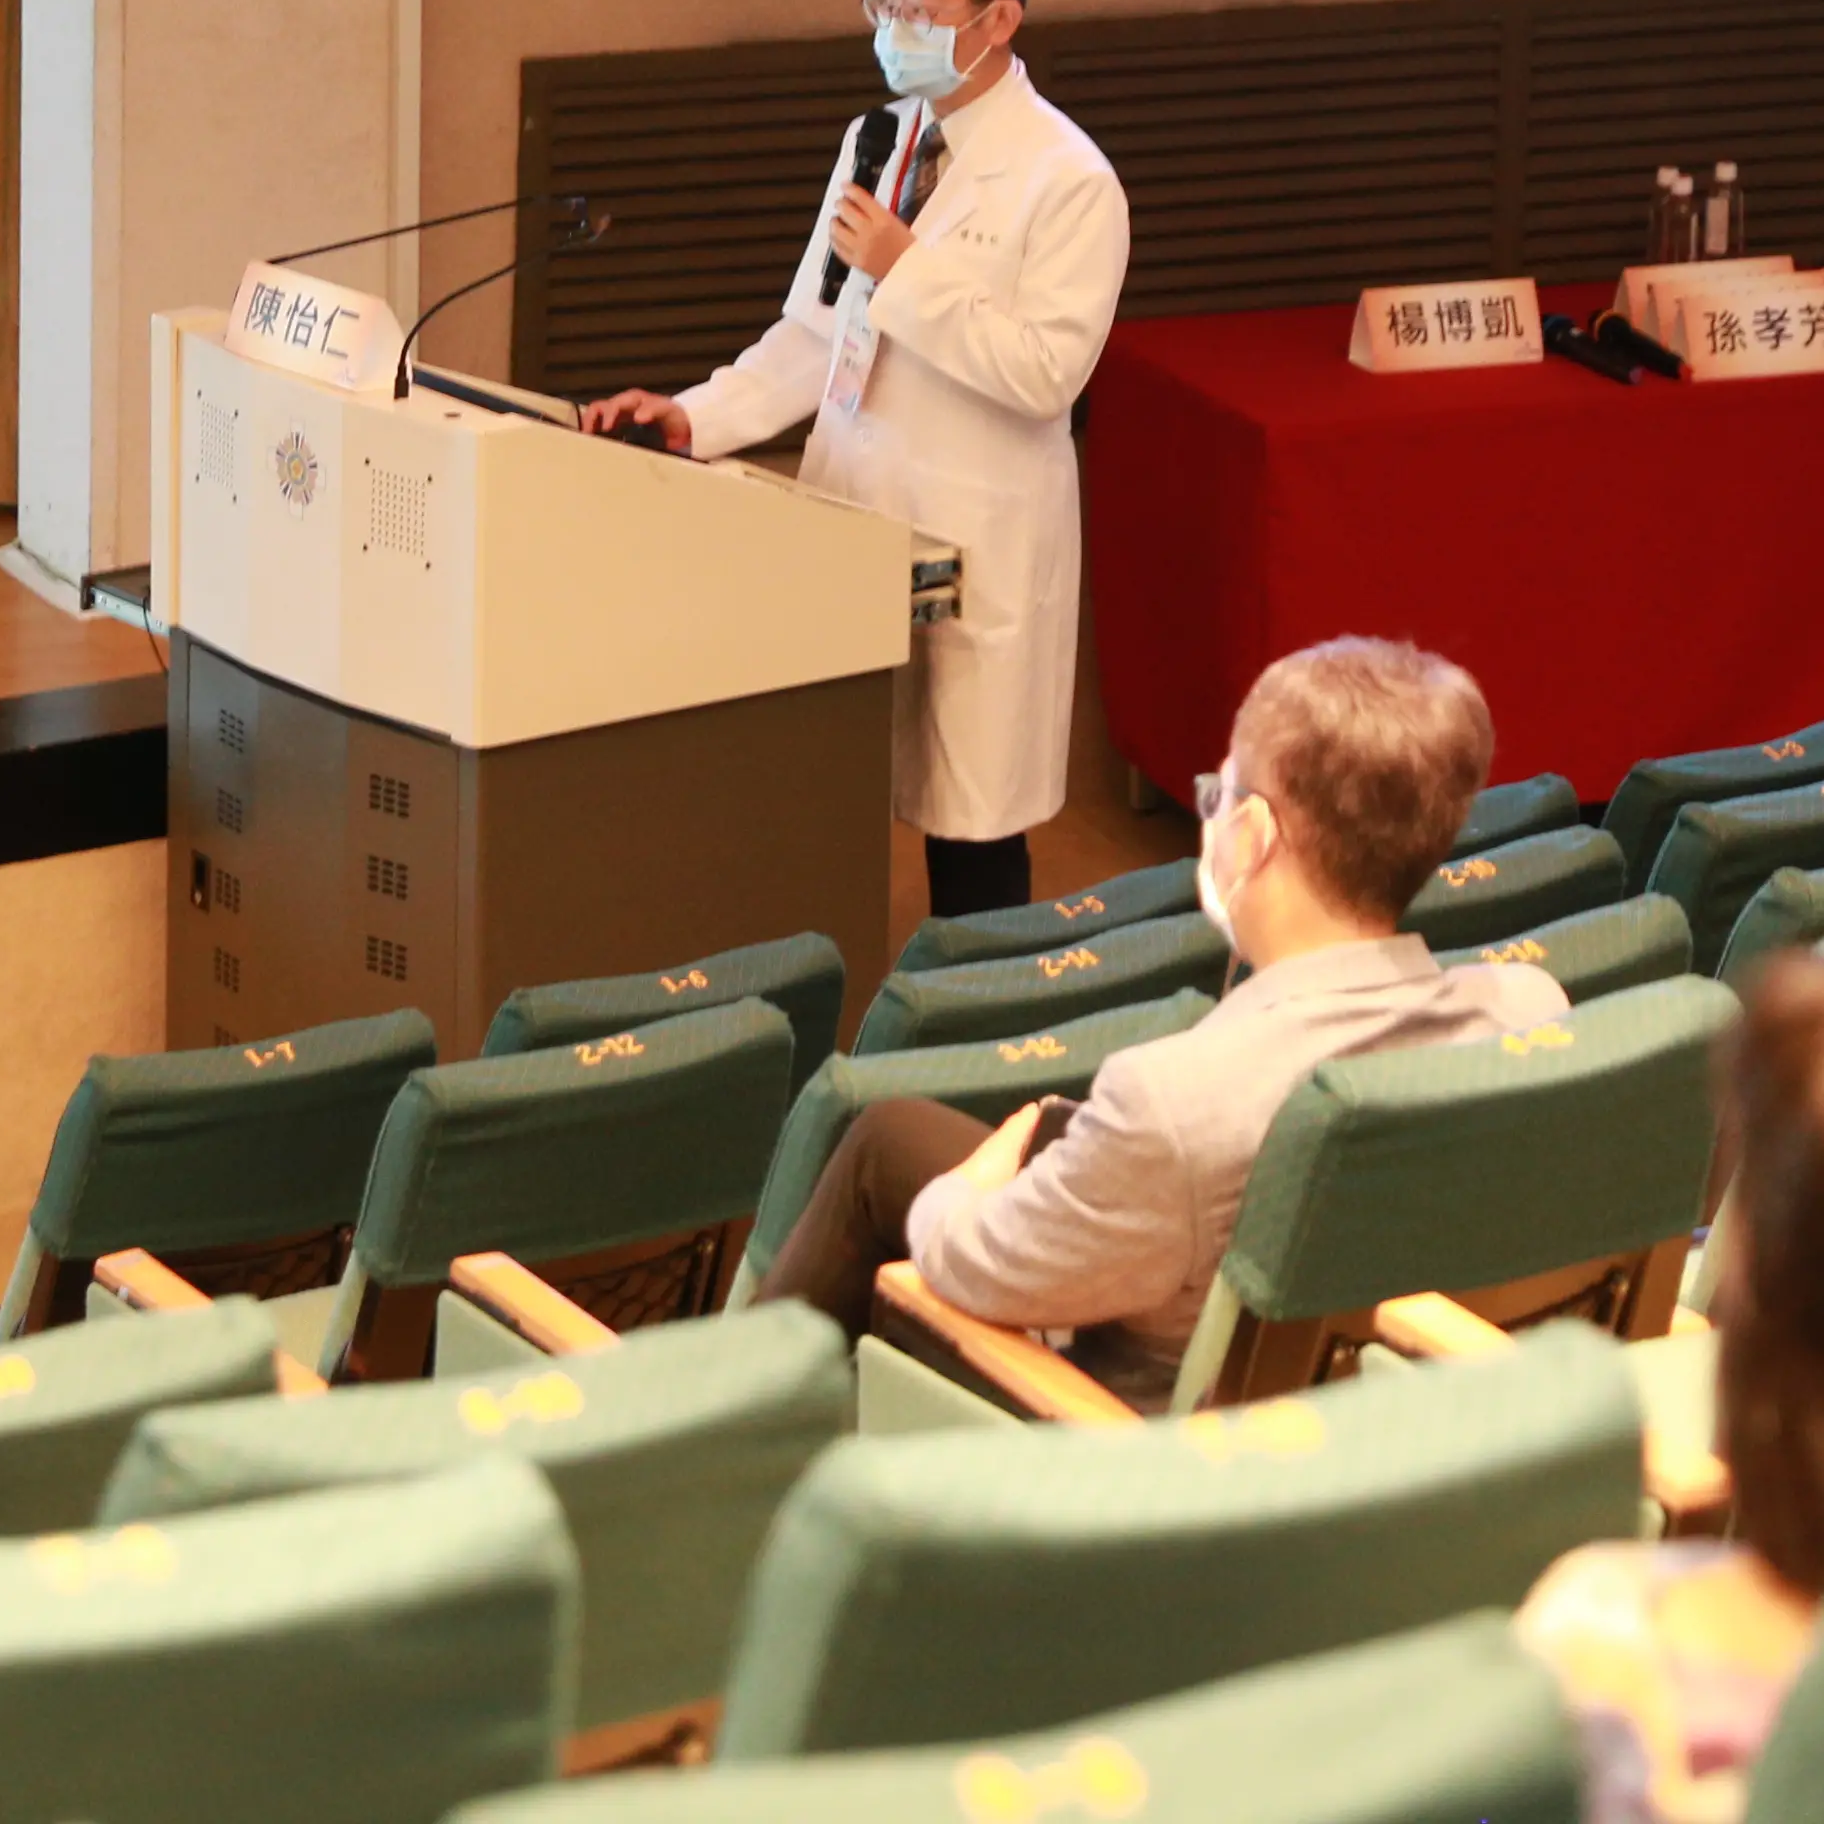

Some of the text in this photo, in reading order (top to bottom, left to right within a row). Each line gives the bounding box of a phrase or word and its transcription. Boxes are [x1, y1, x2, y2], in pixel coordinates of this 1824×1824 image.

[243, 280, 360, 360] 陳怡仁
[1386, 294, 1524, 348] 楊博凱
[660, 968, 709, 995] 1-6
[244, 1040, 296, 1069] 1-7
[575, 1033, 645, 1066] 2-12
